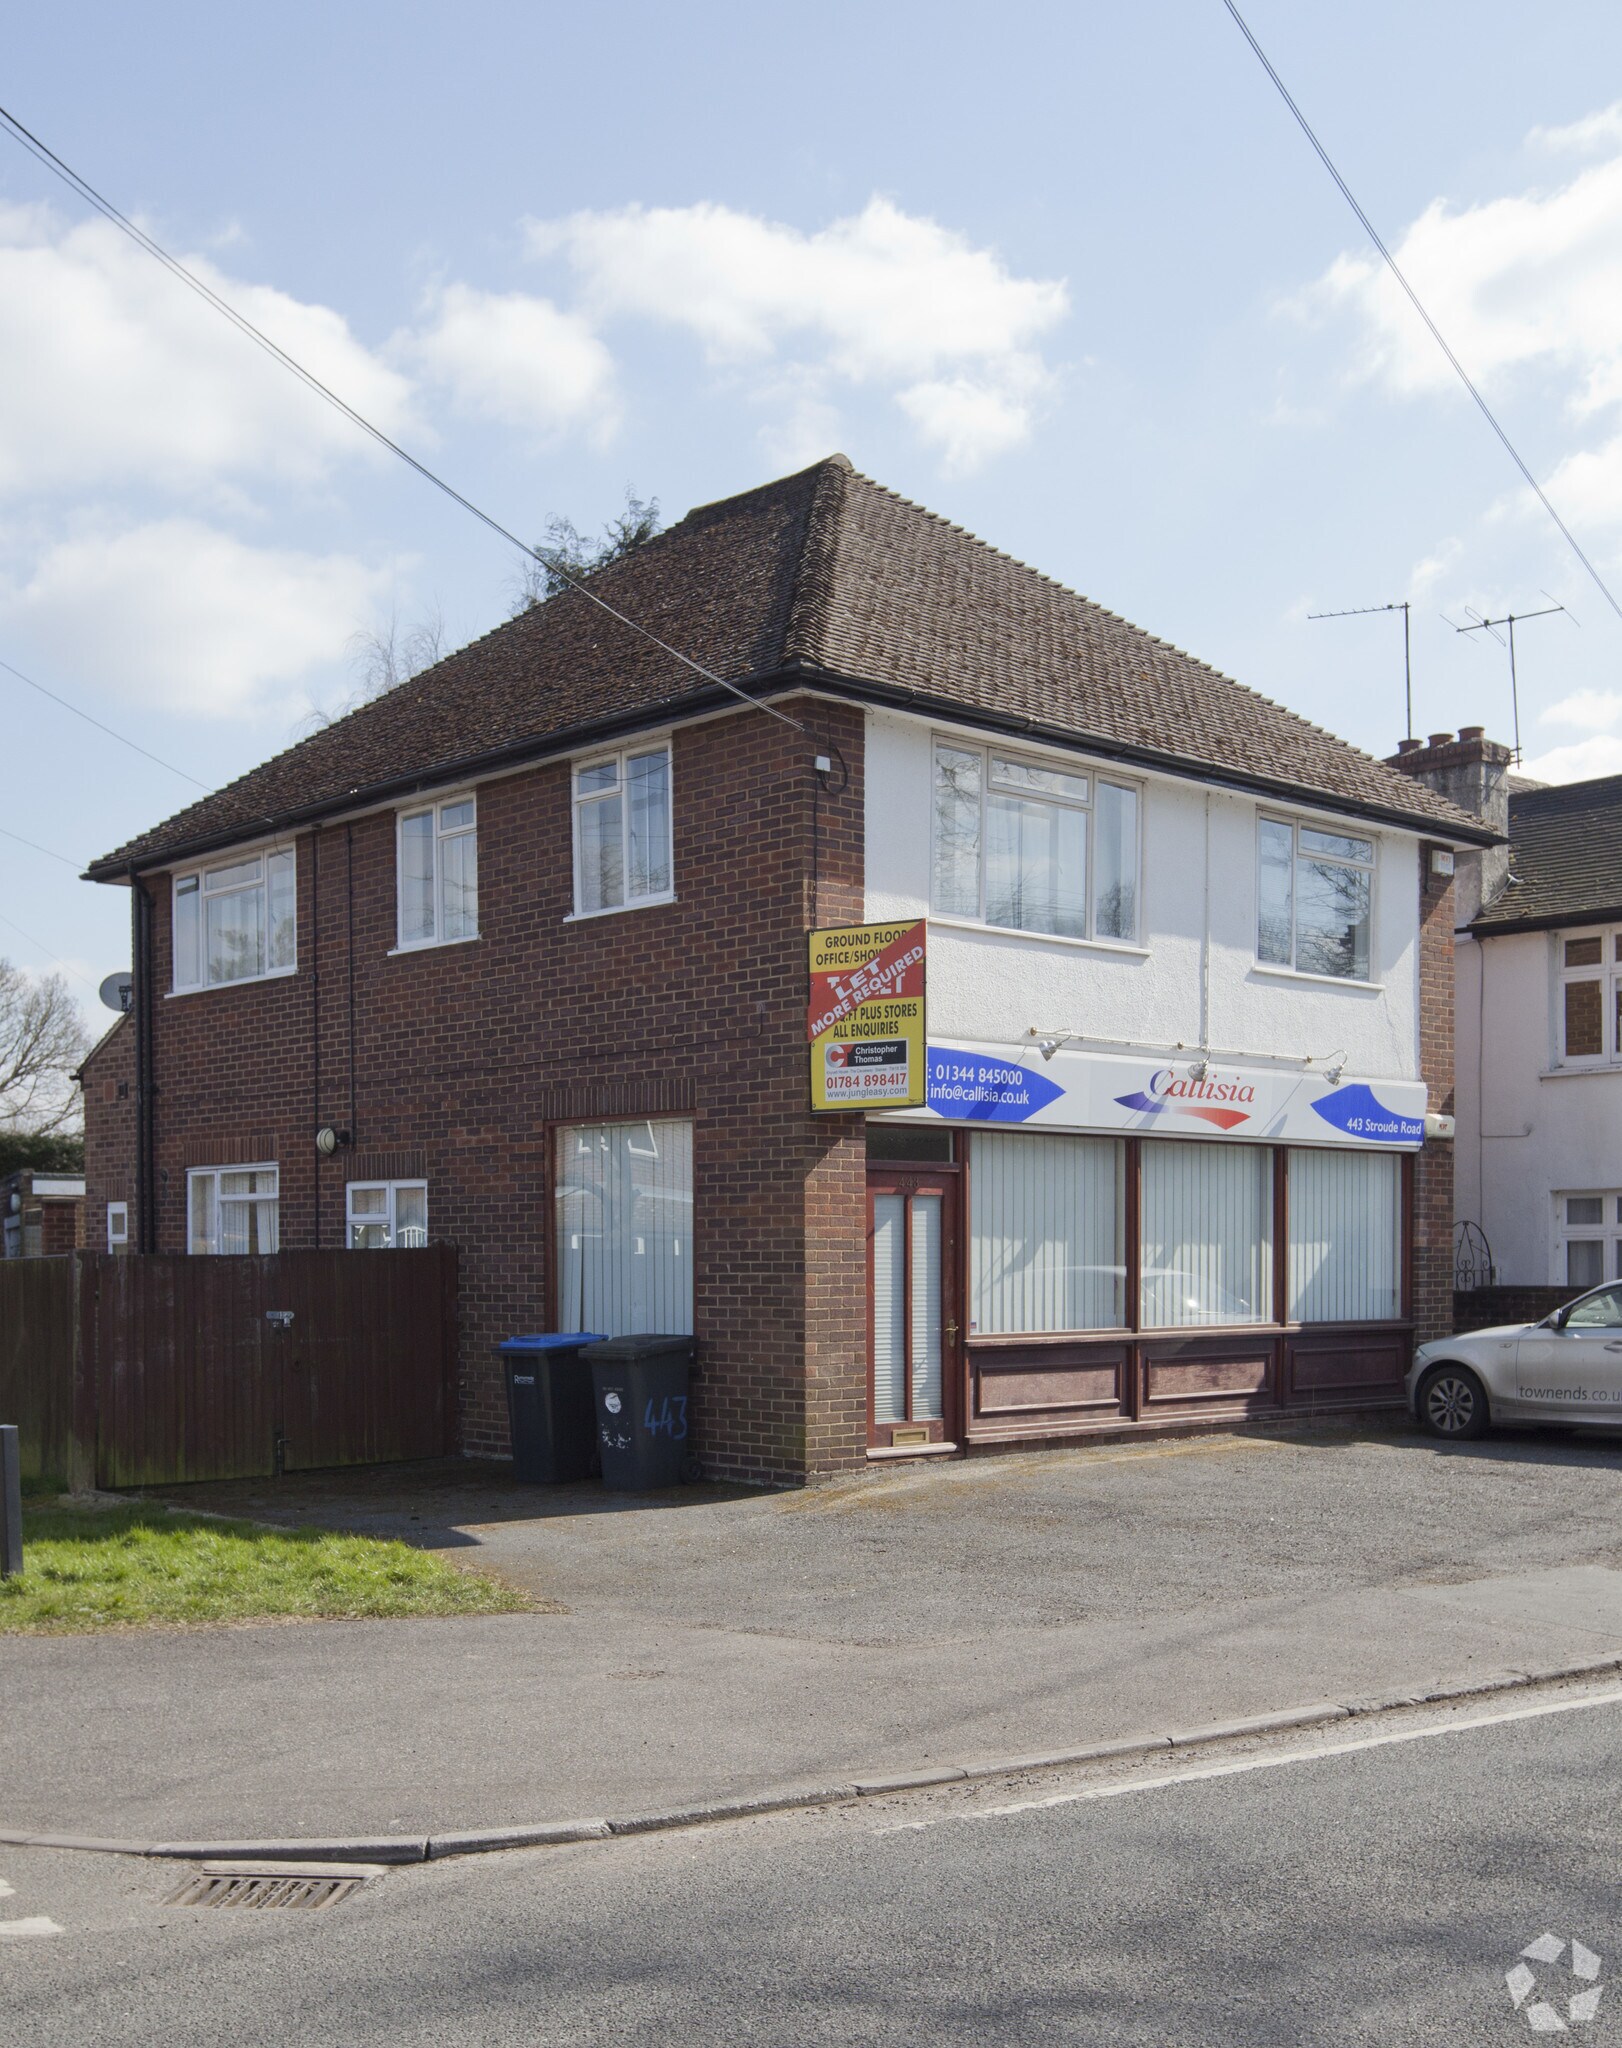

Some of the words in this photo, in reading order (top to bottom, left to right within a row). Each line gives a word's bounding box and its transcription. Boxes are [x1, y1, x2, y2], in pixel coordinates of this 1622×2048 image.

[825, 933, 871, 948] GROUND
[835, 957, 880, 1000] LET
[811, 999, 852, 1036] MORE
[852, 946, 924, 1004] REQUIRED
[860, 1006, 882, 1021] PLUS
[884, 1003, 917, 1019] STORES
[833, 1025, 848, 1038] ALL
[851, 1021, 899, 1037] ENQUIRIES
[855, 1045, 898, 1055] Christopher
[855, 1055, 883, 1064] Thomas
[826, 1075, 860, 1089] 01784
[864, 1072, 907, 1087] 898417
[935, 1064, 974, 1082] 01344
[978, 1067, 1023, 1086] 845000
[827, 1086, 908, 1099] www.jungleasy.com
[930, 1083, 1030, 1105] info@callisia.co.uk
[1150, 1069, 1255, 1103] Callisia
[1347, 1117, 1363, 1131] 443
[1365, 1118, 1399, 1133] Stroude
[1401, 1120, 1422, 1135] Road
[898, 1175, 920, 1188] 443
[1519, 1385, 1622, 1402] townends.co.u
[643, 1395, 688, 1441] 443
